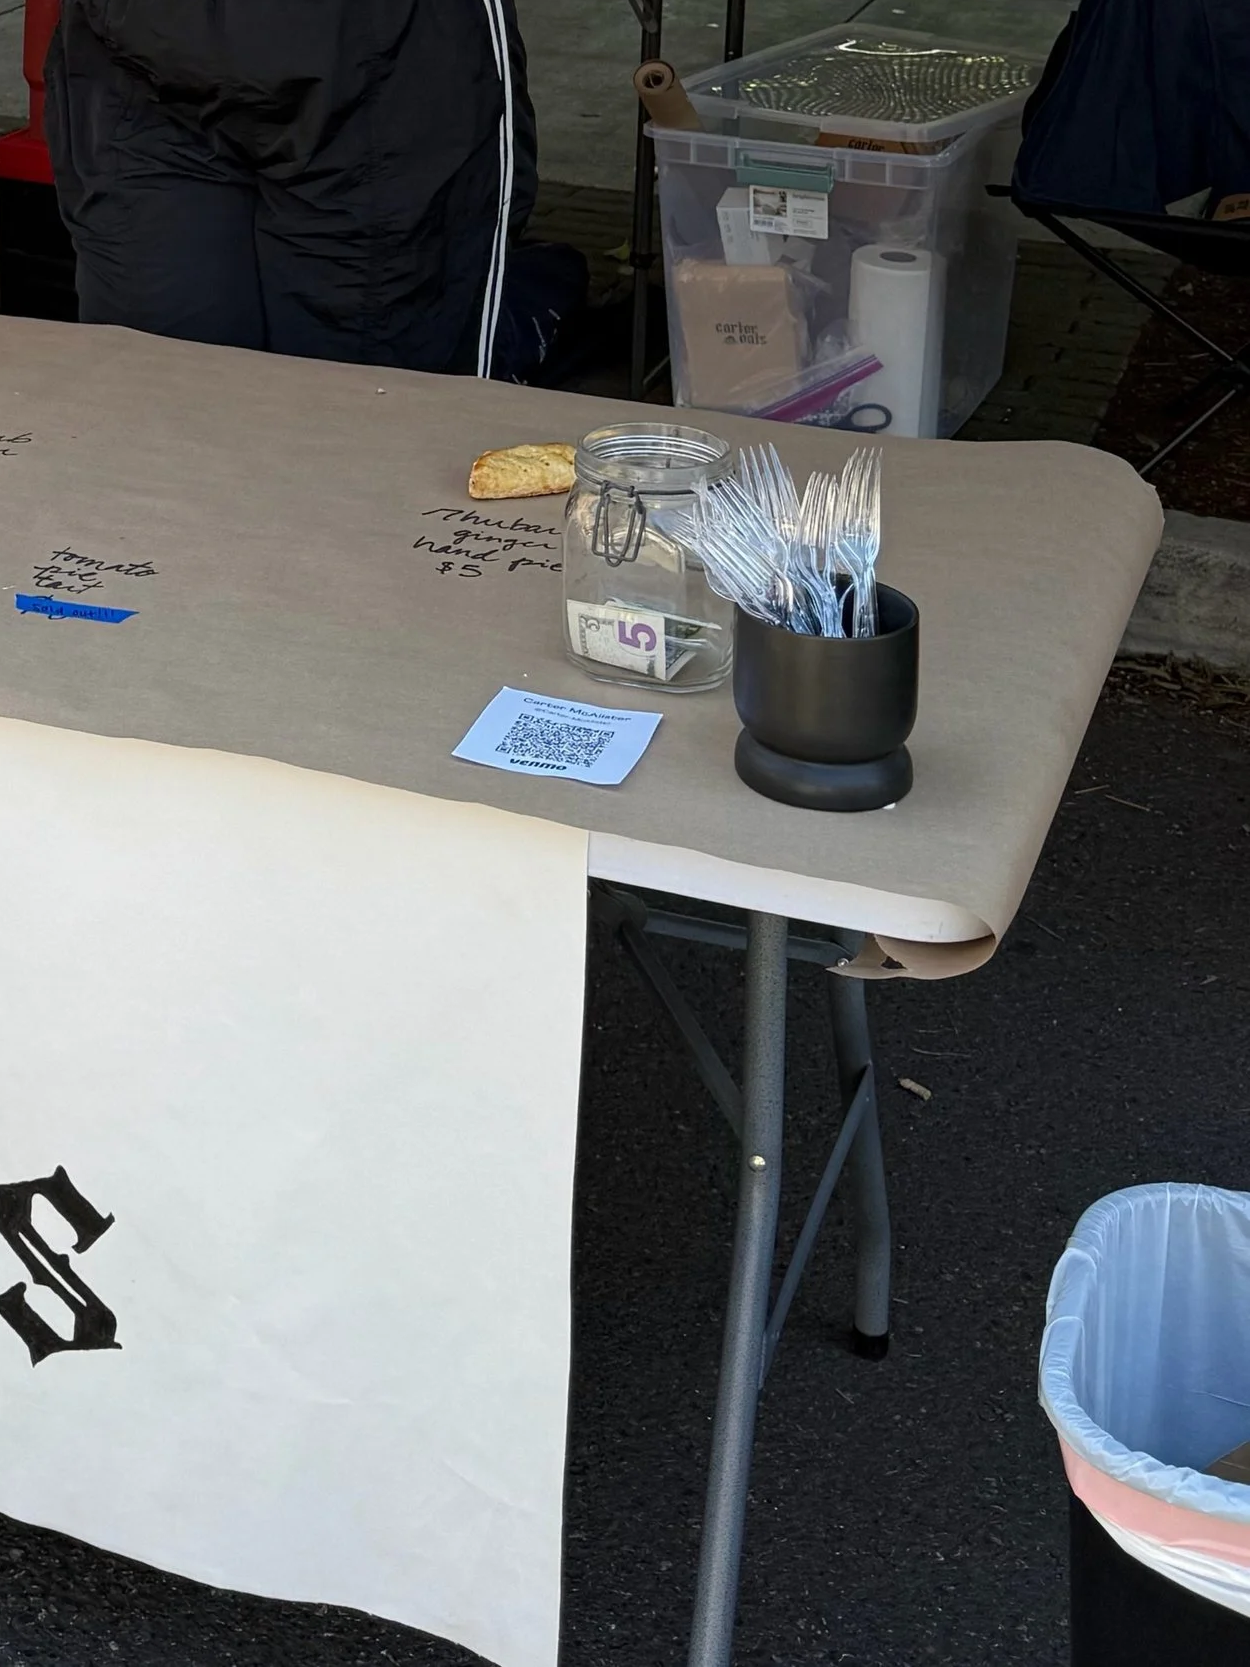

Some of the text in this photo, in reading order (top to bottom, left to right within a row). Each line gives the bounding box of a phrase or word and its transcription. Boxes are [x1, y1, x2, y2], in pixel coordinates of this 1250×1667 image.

[715, 321, 758, 334] carter
[422, 508, 562, 535] rhubar
[452, 529, 557, 551] ginger
[50, 546, 160, 577] tomato
[413, 536, 563, 572] hand pie
[32, 565, 99, 582] pie
[435, 561, 483, 578] $5
[34, 574, 105, 595] tart
[618, 620, 658, 652] 5
[523, 697, 632, 722] Carter McAlister
[509, 758, 568, 771] venmo
